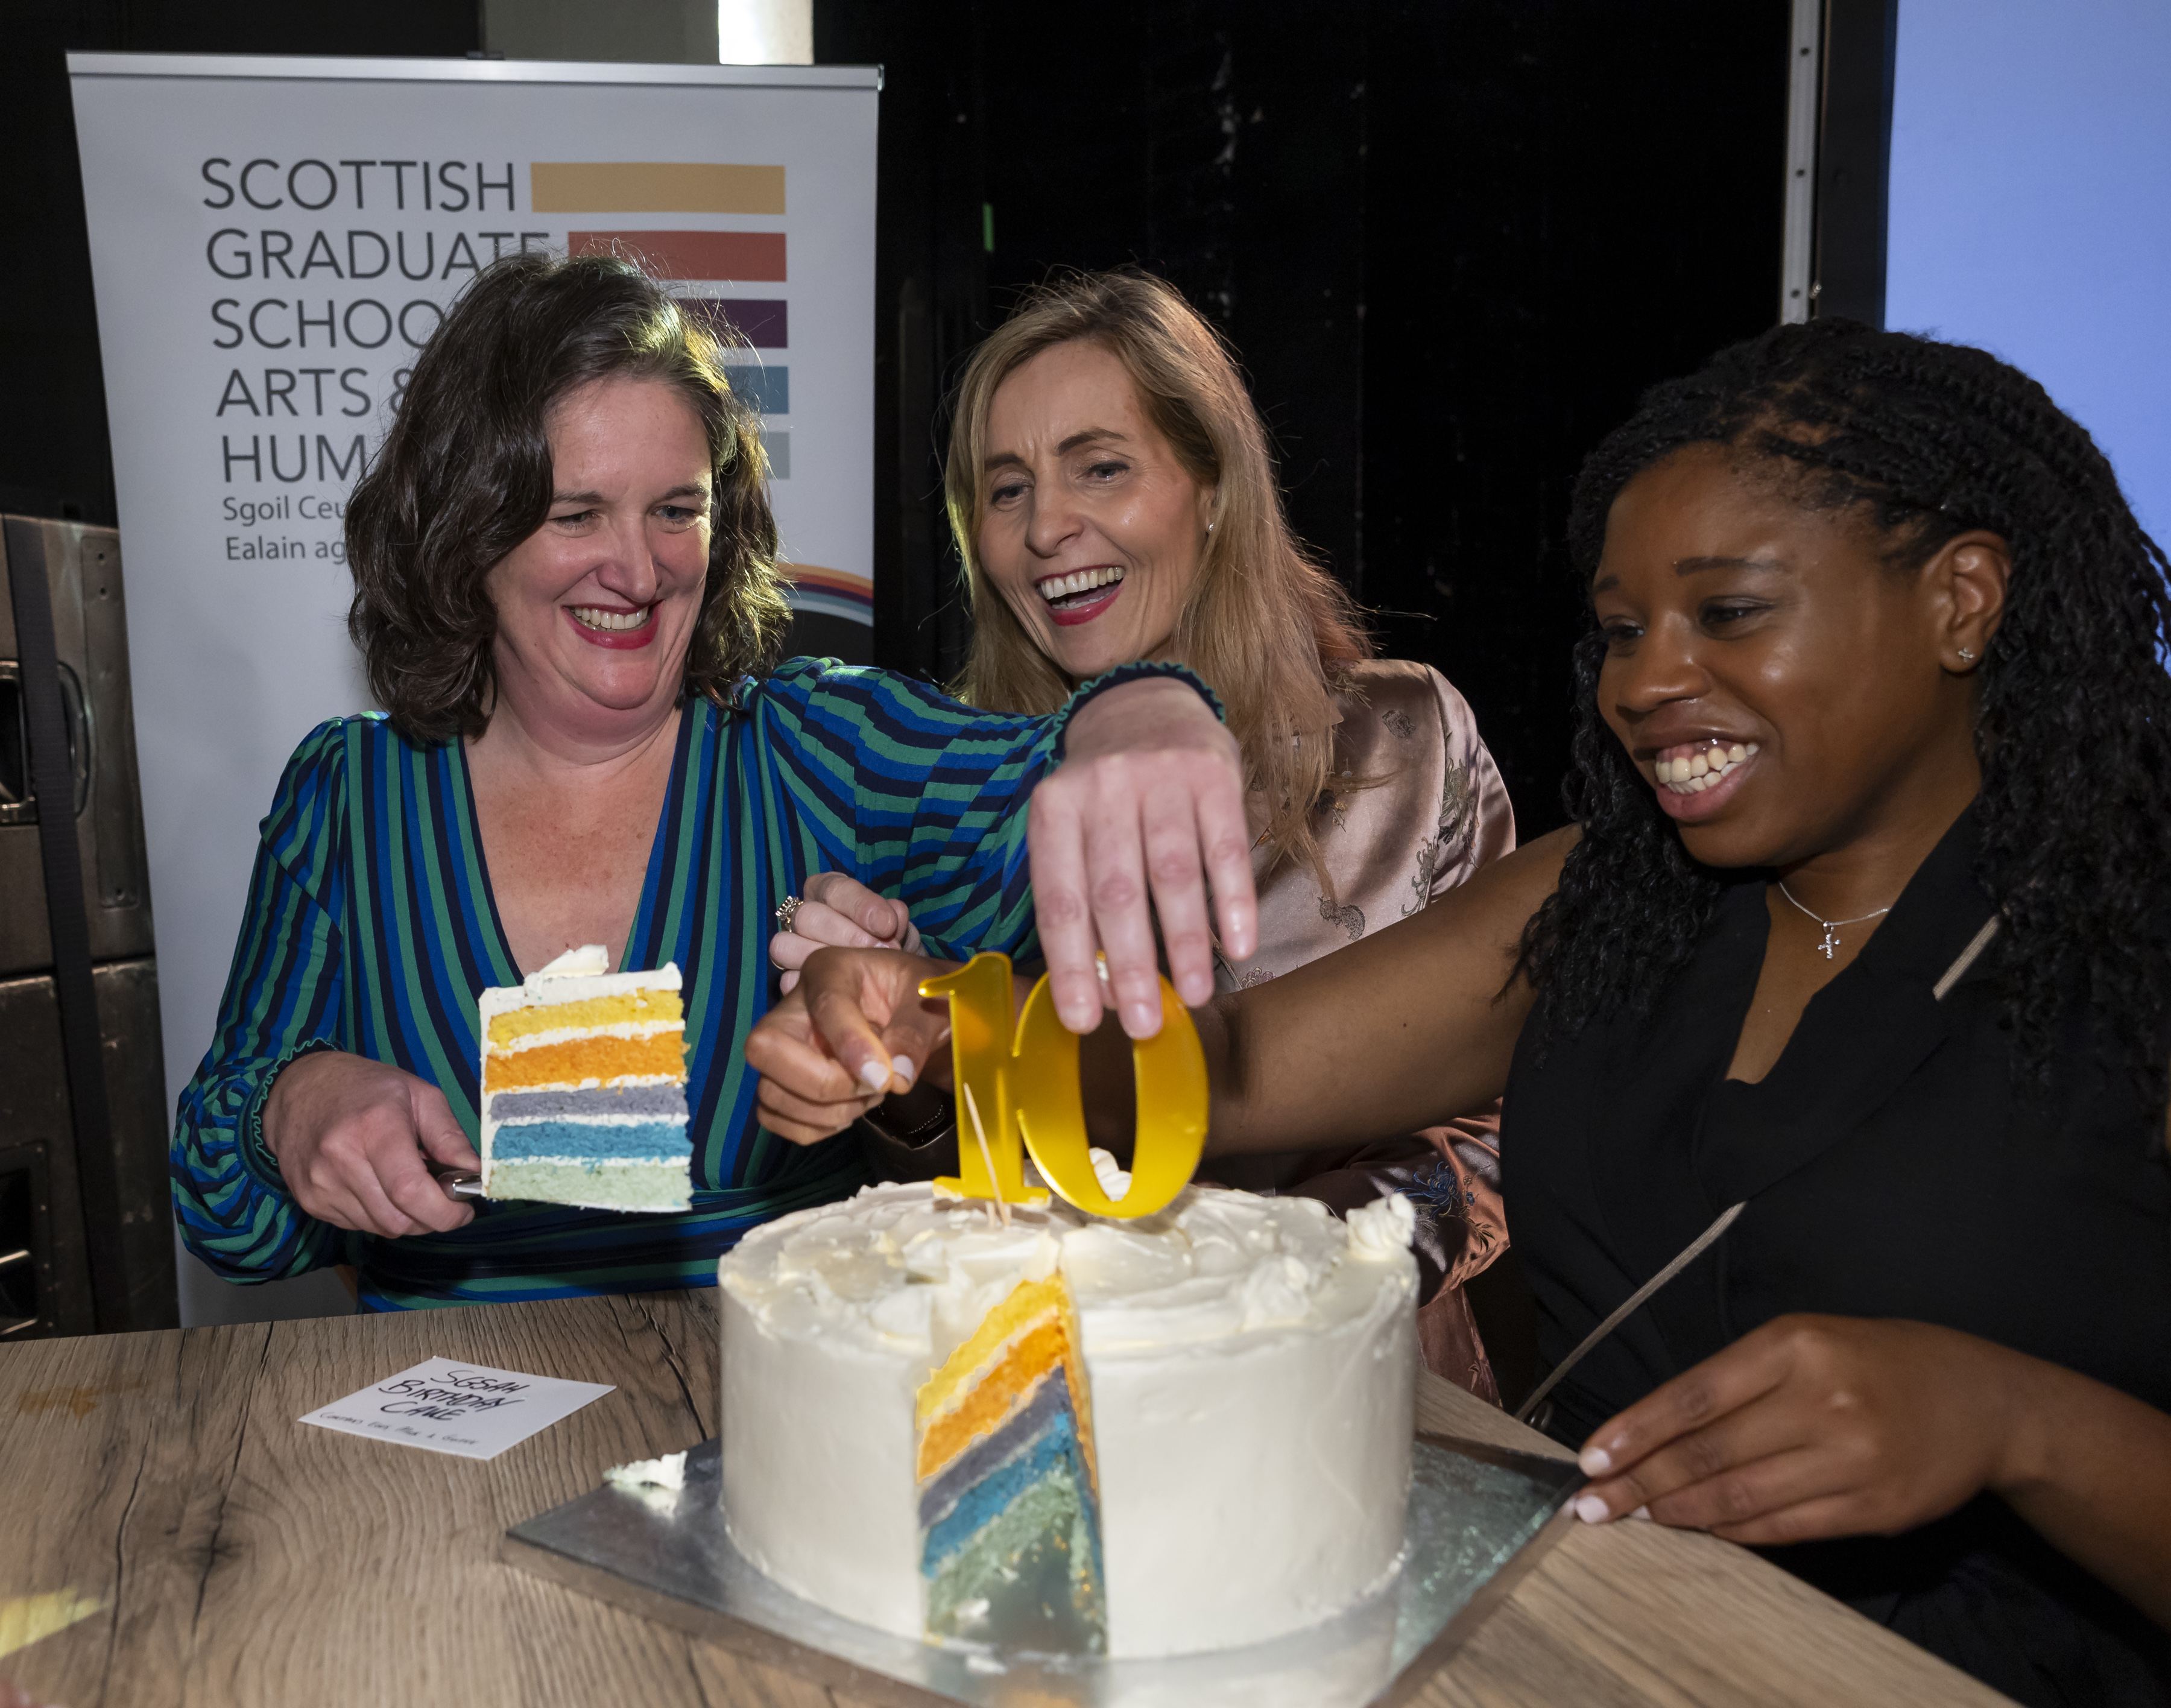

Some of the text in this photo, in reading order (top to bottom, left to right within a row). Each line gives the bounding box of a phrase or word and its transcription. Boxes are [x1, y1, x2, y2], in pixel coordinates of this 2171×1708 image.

[201, 157, 515, 212] SCOTTISH
[211, 298, 461, 350] SCHOO
[216, 368, 371, 417] ARTS
[223, 495, 290, 527] Sgoil
[226, 535, 306, 561] Ealain
[918, 951, 1209, 1219] 10
[378, 1379, 526, 1412] BIRTHDAY
[430, 1369, 531, 1394] SGSAH
[380, 1400, 467, 1421] CAKE
